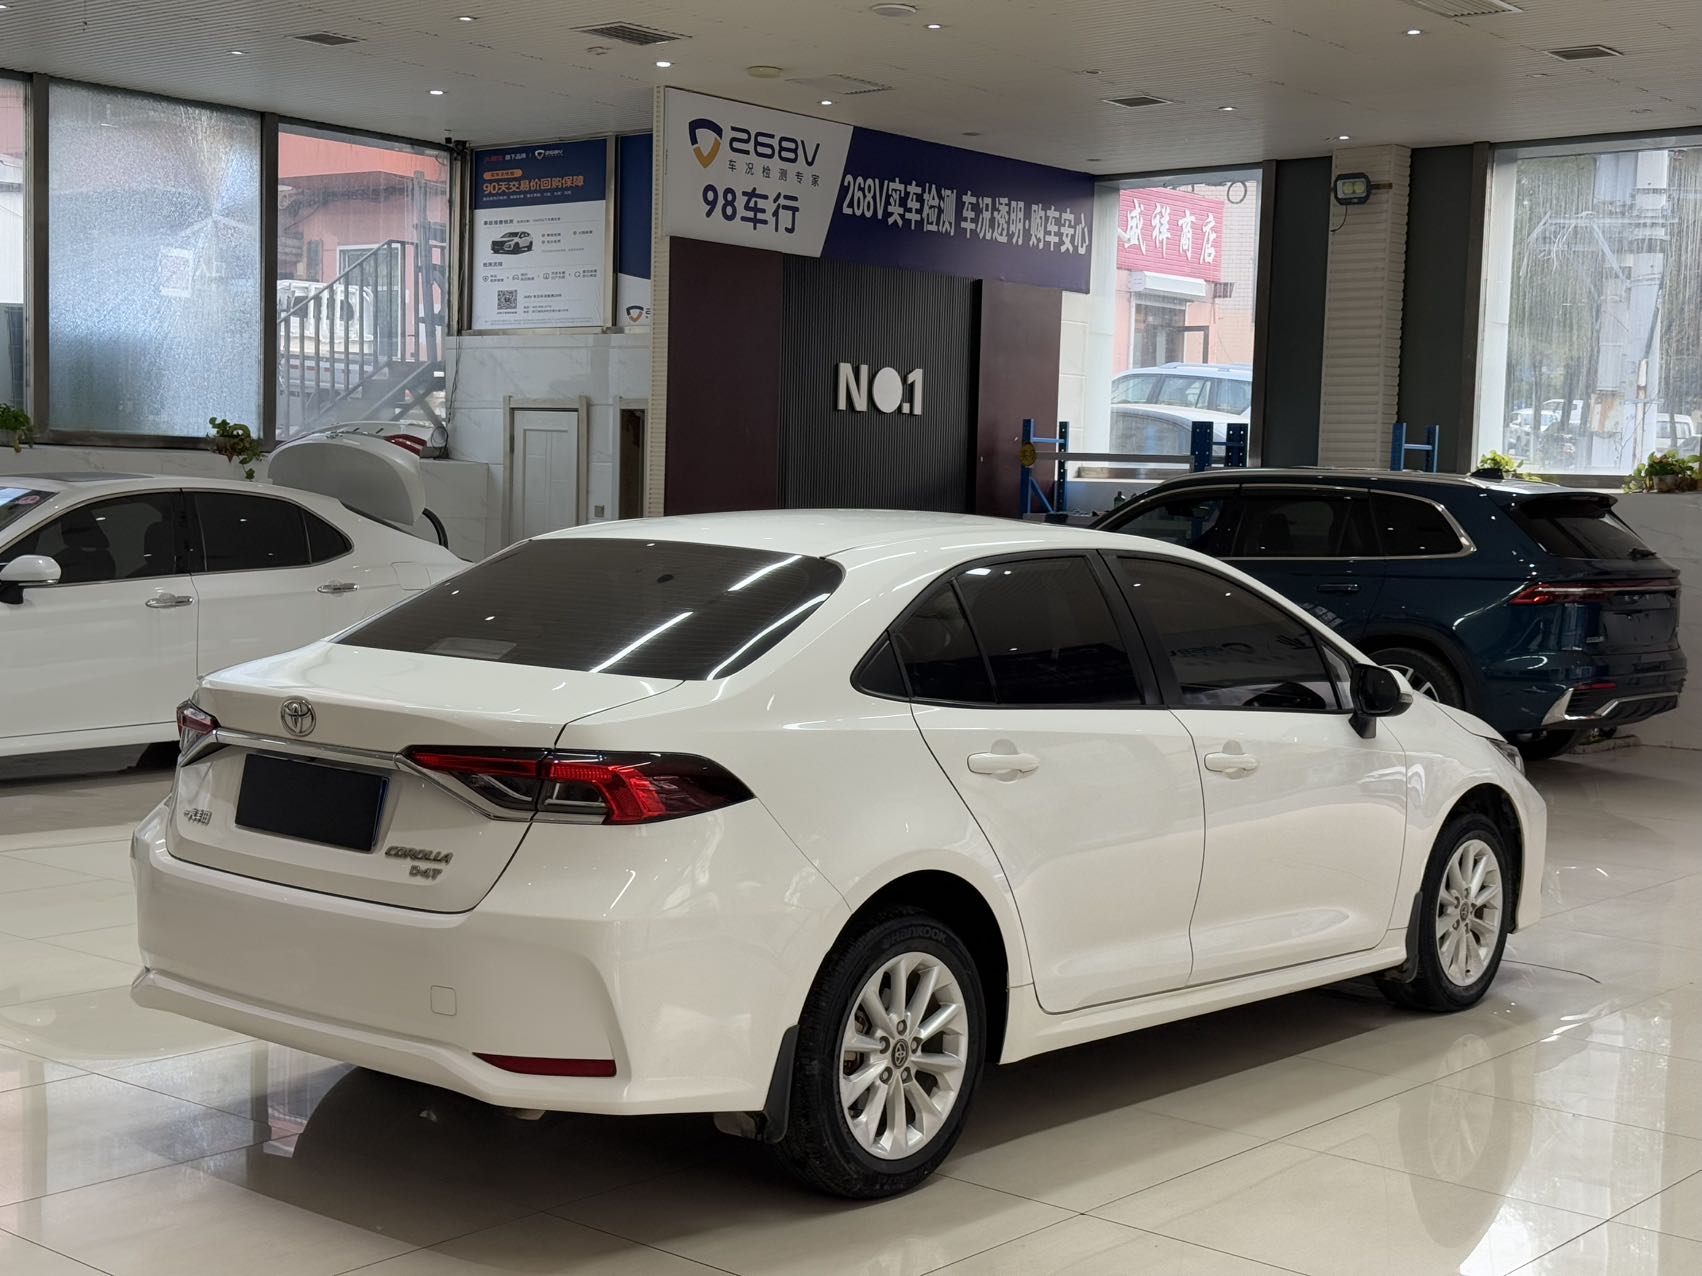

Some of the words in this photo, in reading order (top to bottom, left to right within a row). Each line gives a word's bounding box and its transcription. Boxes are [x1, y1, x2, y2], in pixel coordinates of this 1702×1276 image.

[728, 125, 820, 168] 268V
[483, 175, 585, 195] 90天交易价回购保障
[727, 159, 820, 188] 车况检测专家
[702, 184, 800, 235] 98车行
[842, 174, 956, 237] 268V实车检测
[960, 190, 1089, 256] 车况透明·购车安心
[837, 362, 924, 415] NO.1
[385, 846, 453, 865] COROLLA
